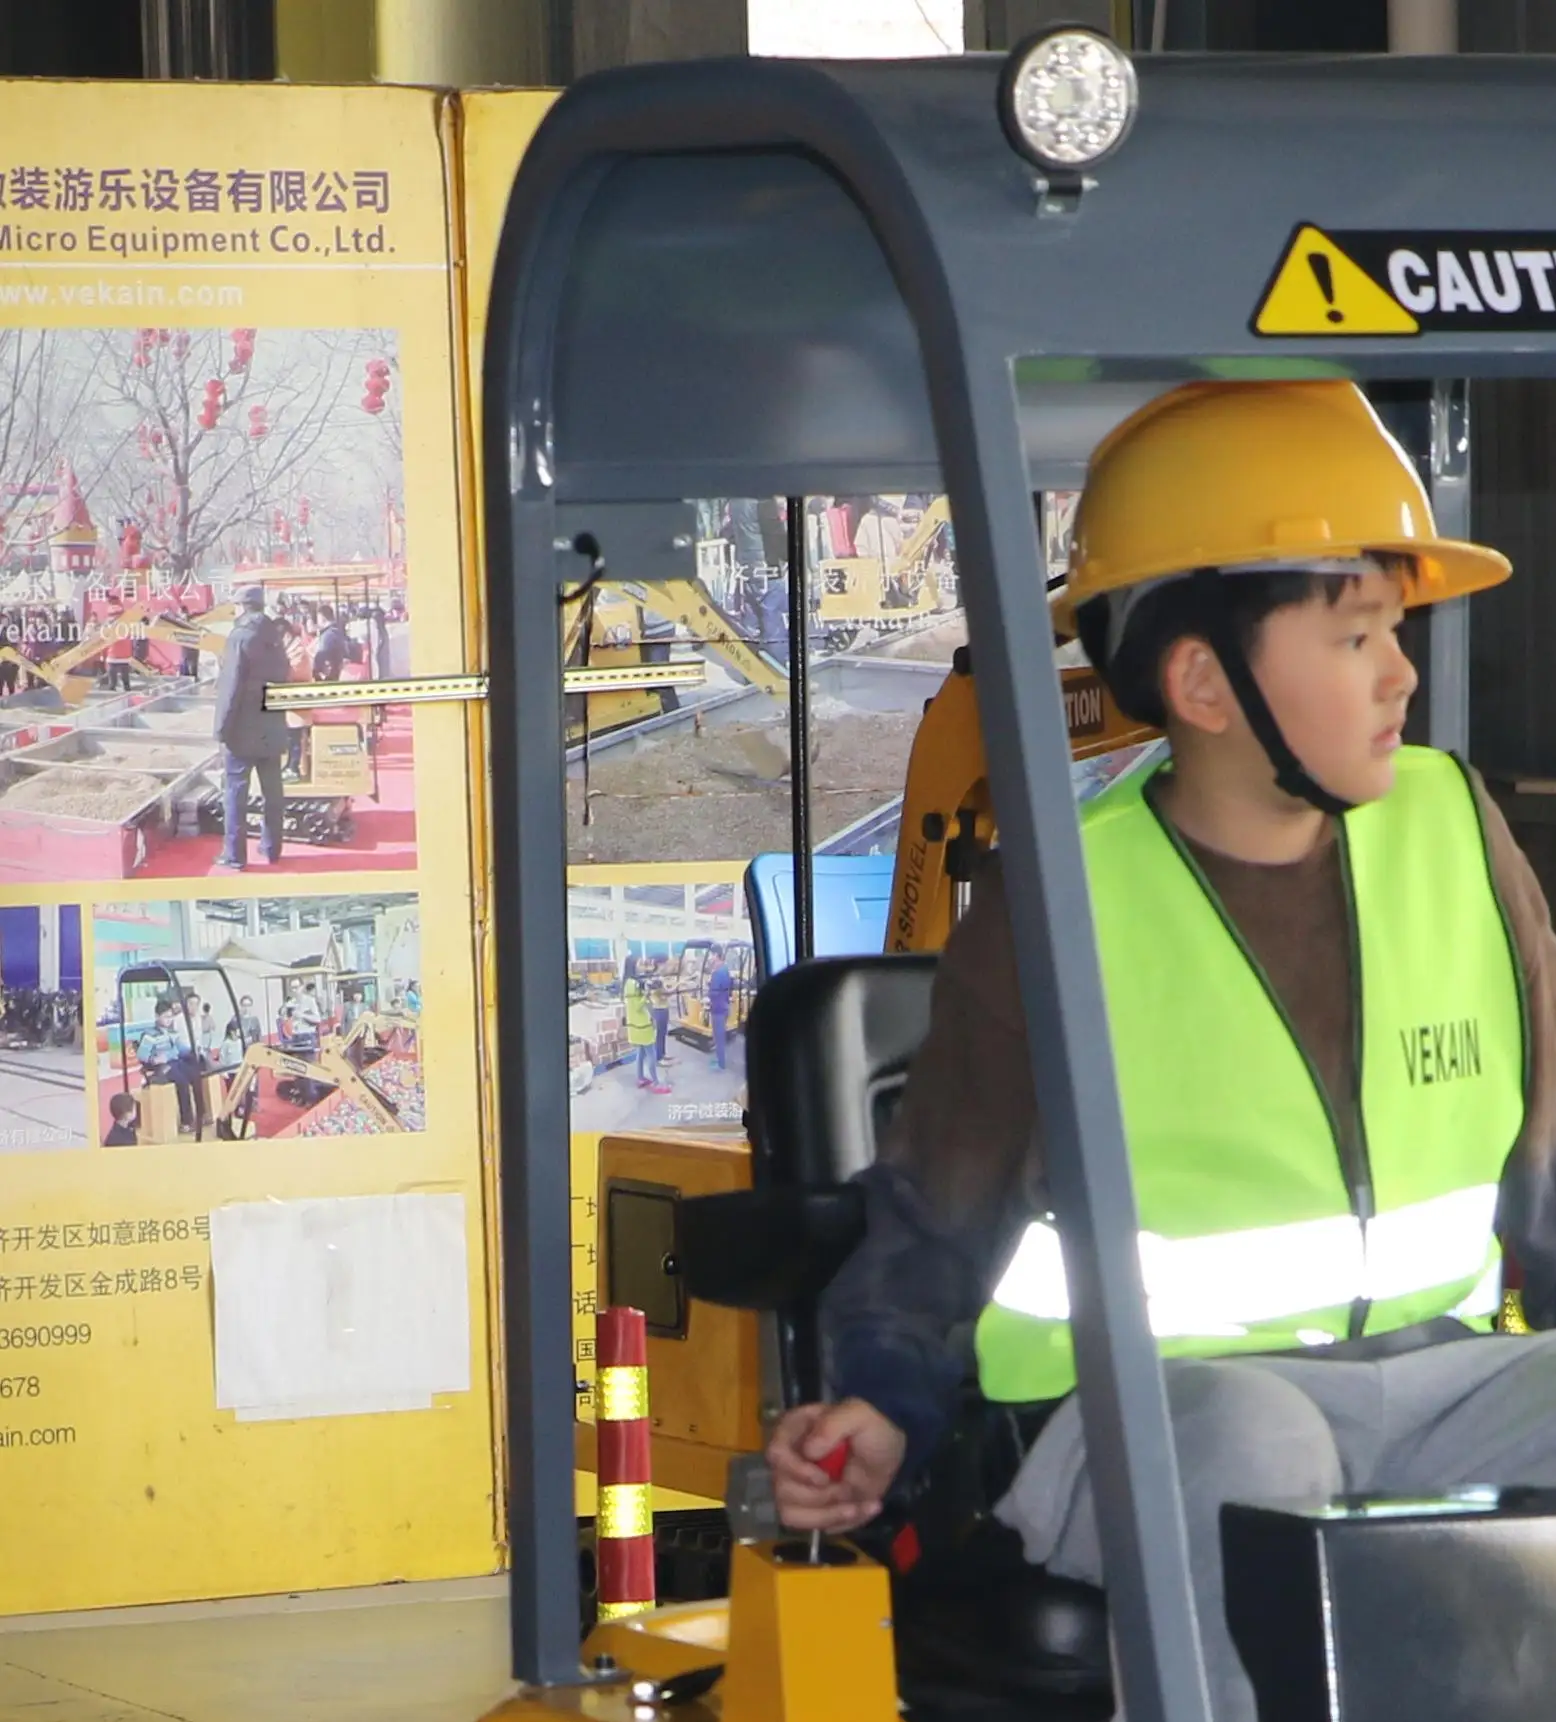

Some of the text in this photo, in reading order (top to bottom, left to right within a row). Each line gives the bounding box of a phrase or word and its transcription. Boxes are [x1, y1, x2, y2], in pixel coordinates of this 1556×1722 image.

[0, 166, 390, 214] 装游乐设备有限公司
[87, 225, 260, 259] Equipment
[270, 224, 396, 258] Co.,Ltd.
[1400, 1017, 1481, 1088] VEKAIN
[0, 1375, 41, 1398] 678
